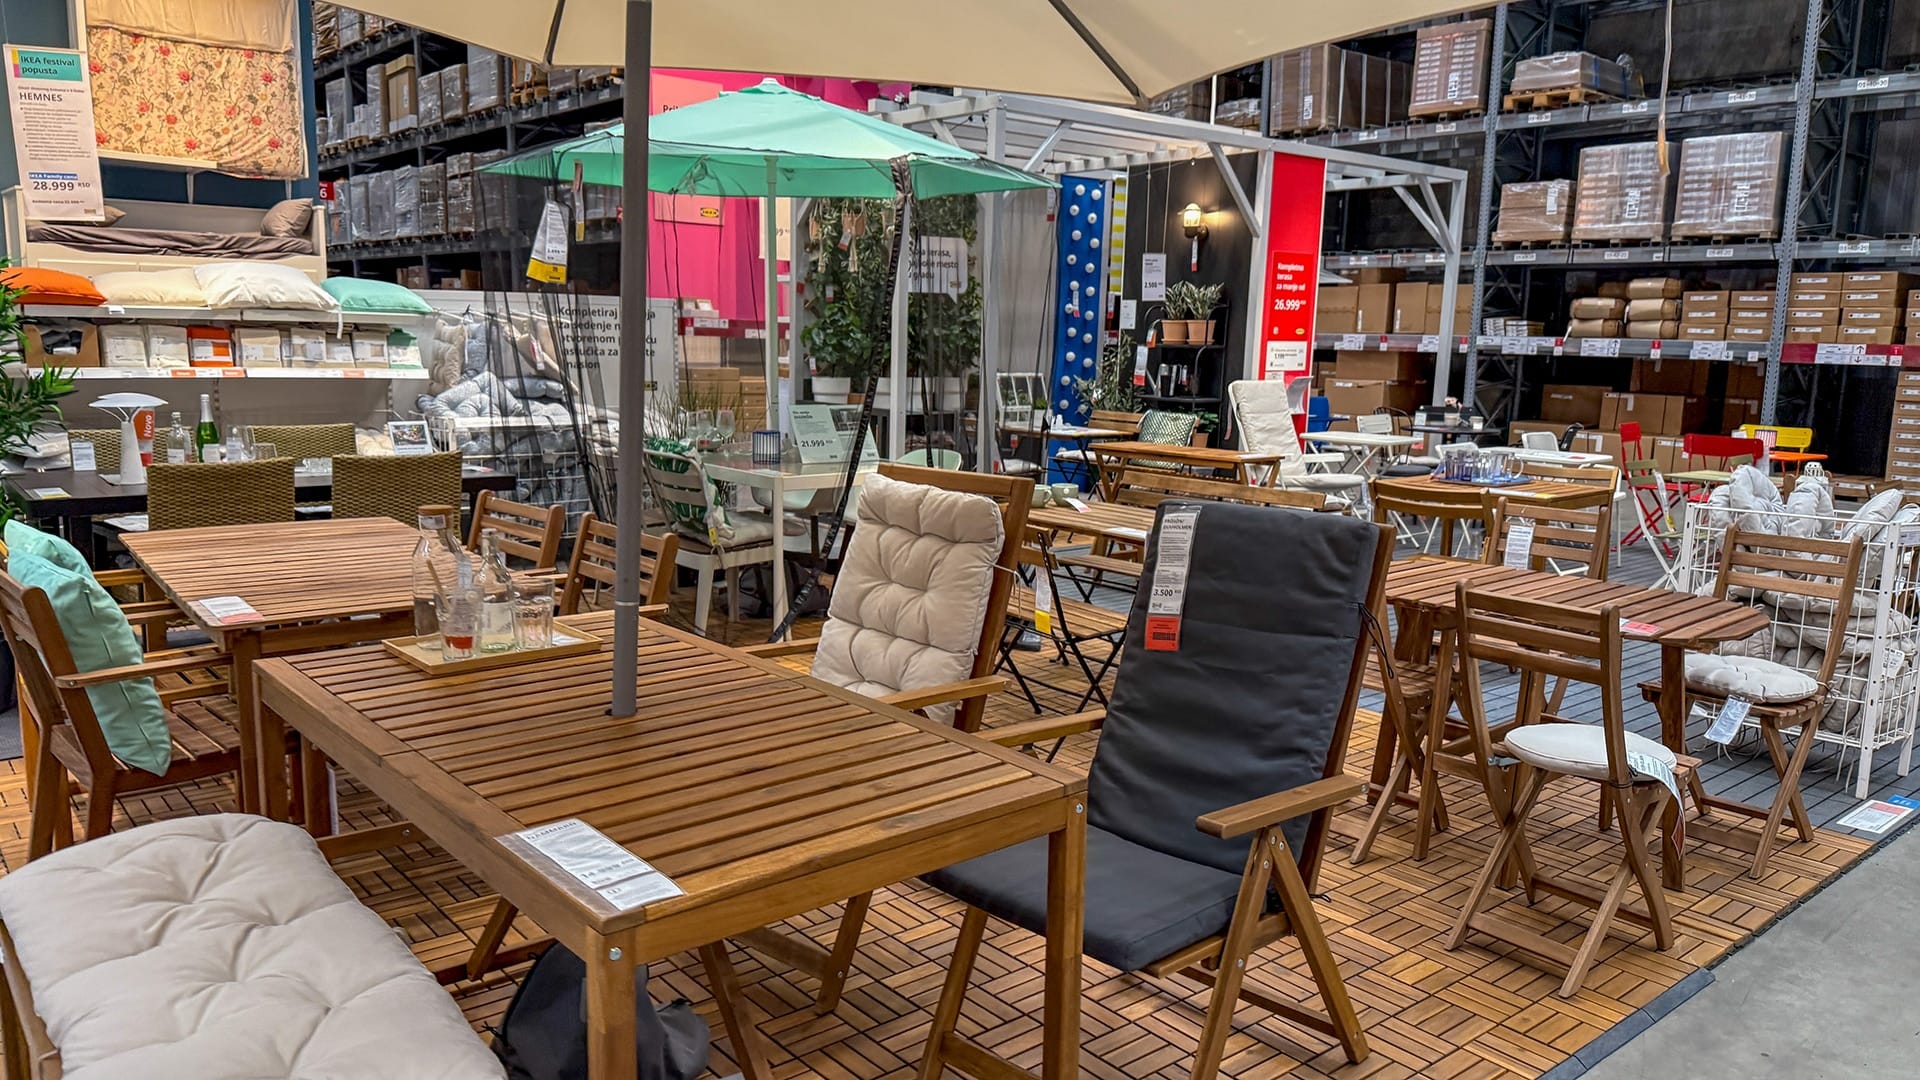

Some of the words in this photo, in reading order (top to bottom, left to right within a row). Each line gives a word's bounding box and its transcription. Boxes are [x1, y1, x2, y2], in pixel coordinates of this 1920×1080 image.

[21, 55, 40, 64] IKEA
[43, 57, 75, 66] festival
[22, 66, 58, 75] popusta
[20, 92, 63, 102] HEMNES
[33, 181, 75, 191] 28.999
[320, 188, 327, 198] 6
[1283, 284, 1298, 292] manje
[1298, 283, 1306, 291] od
[1274, 299, 1300, 310] 26.999
[559, 306, 618, 320] Kompletiraj
[143, 414, 152, 438] Novo
[1153, 588, 1174, 597] 3.500
